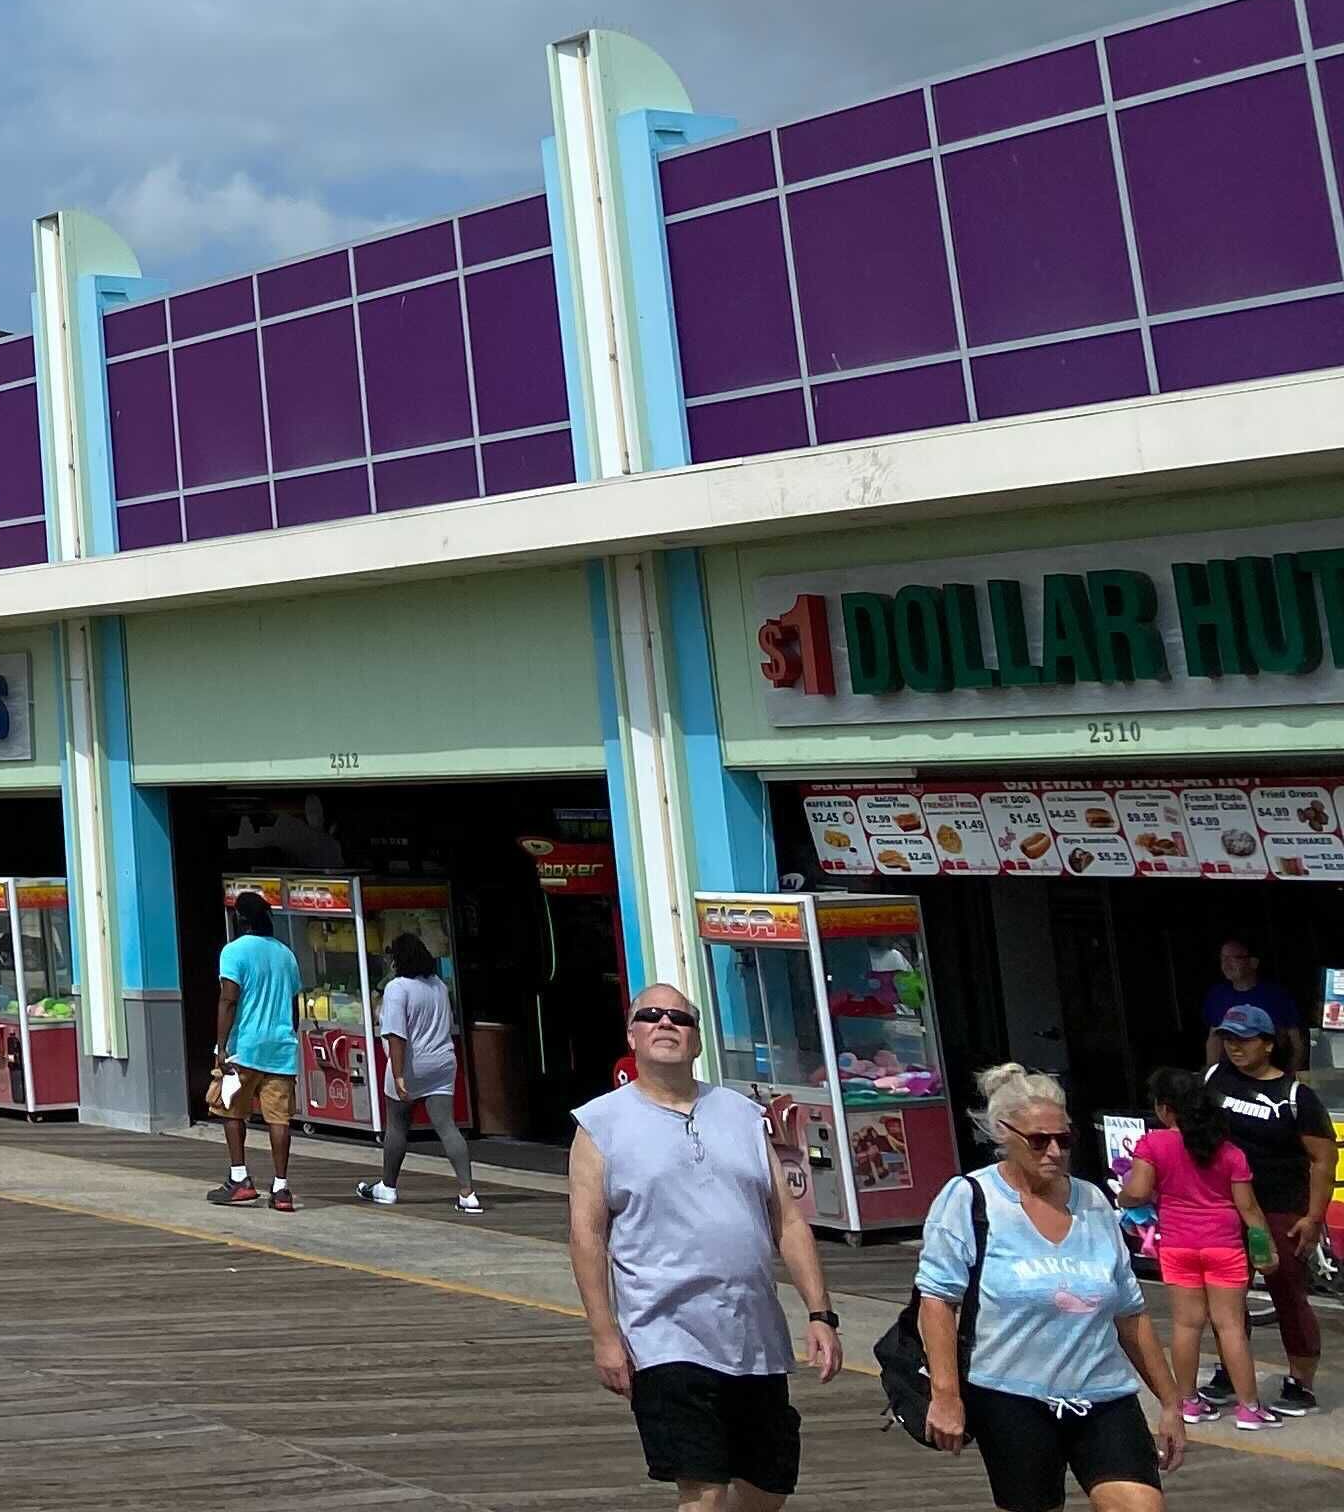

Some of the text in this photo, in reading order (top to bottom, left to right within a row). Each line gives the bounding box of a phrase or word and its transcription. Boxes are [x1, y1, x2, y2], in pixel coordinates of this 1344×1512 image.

[758, 593, 835, 696] $1
[841, 569, 1171, 696] DOLLAR
[1087, 720, 1143, 744] 2510
[329, 752, 360, 769] 2512
[989, 796, 1031, 804] HOT DOG
[812, 812, 839, 823] $2.45
[1009, 813, 1041, 824] $1.45
[954, 820, 984, 830] $1.49
